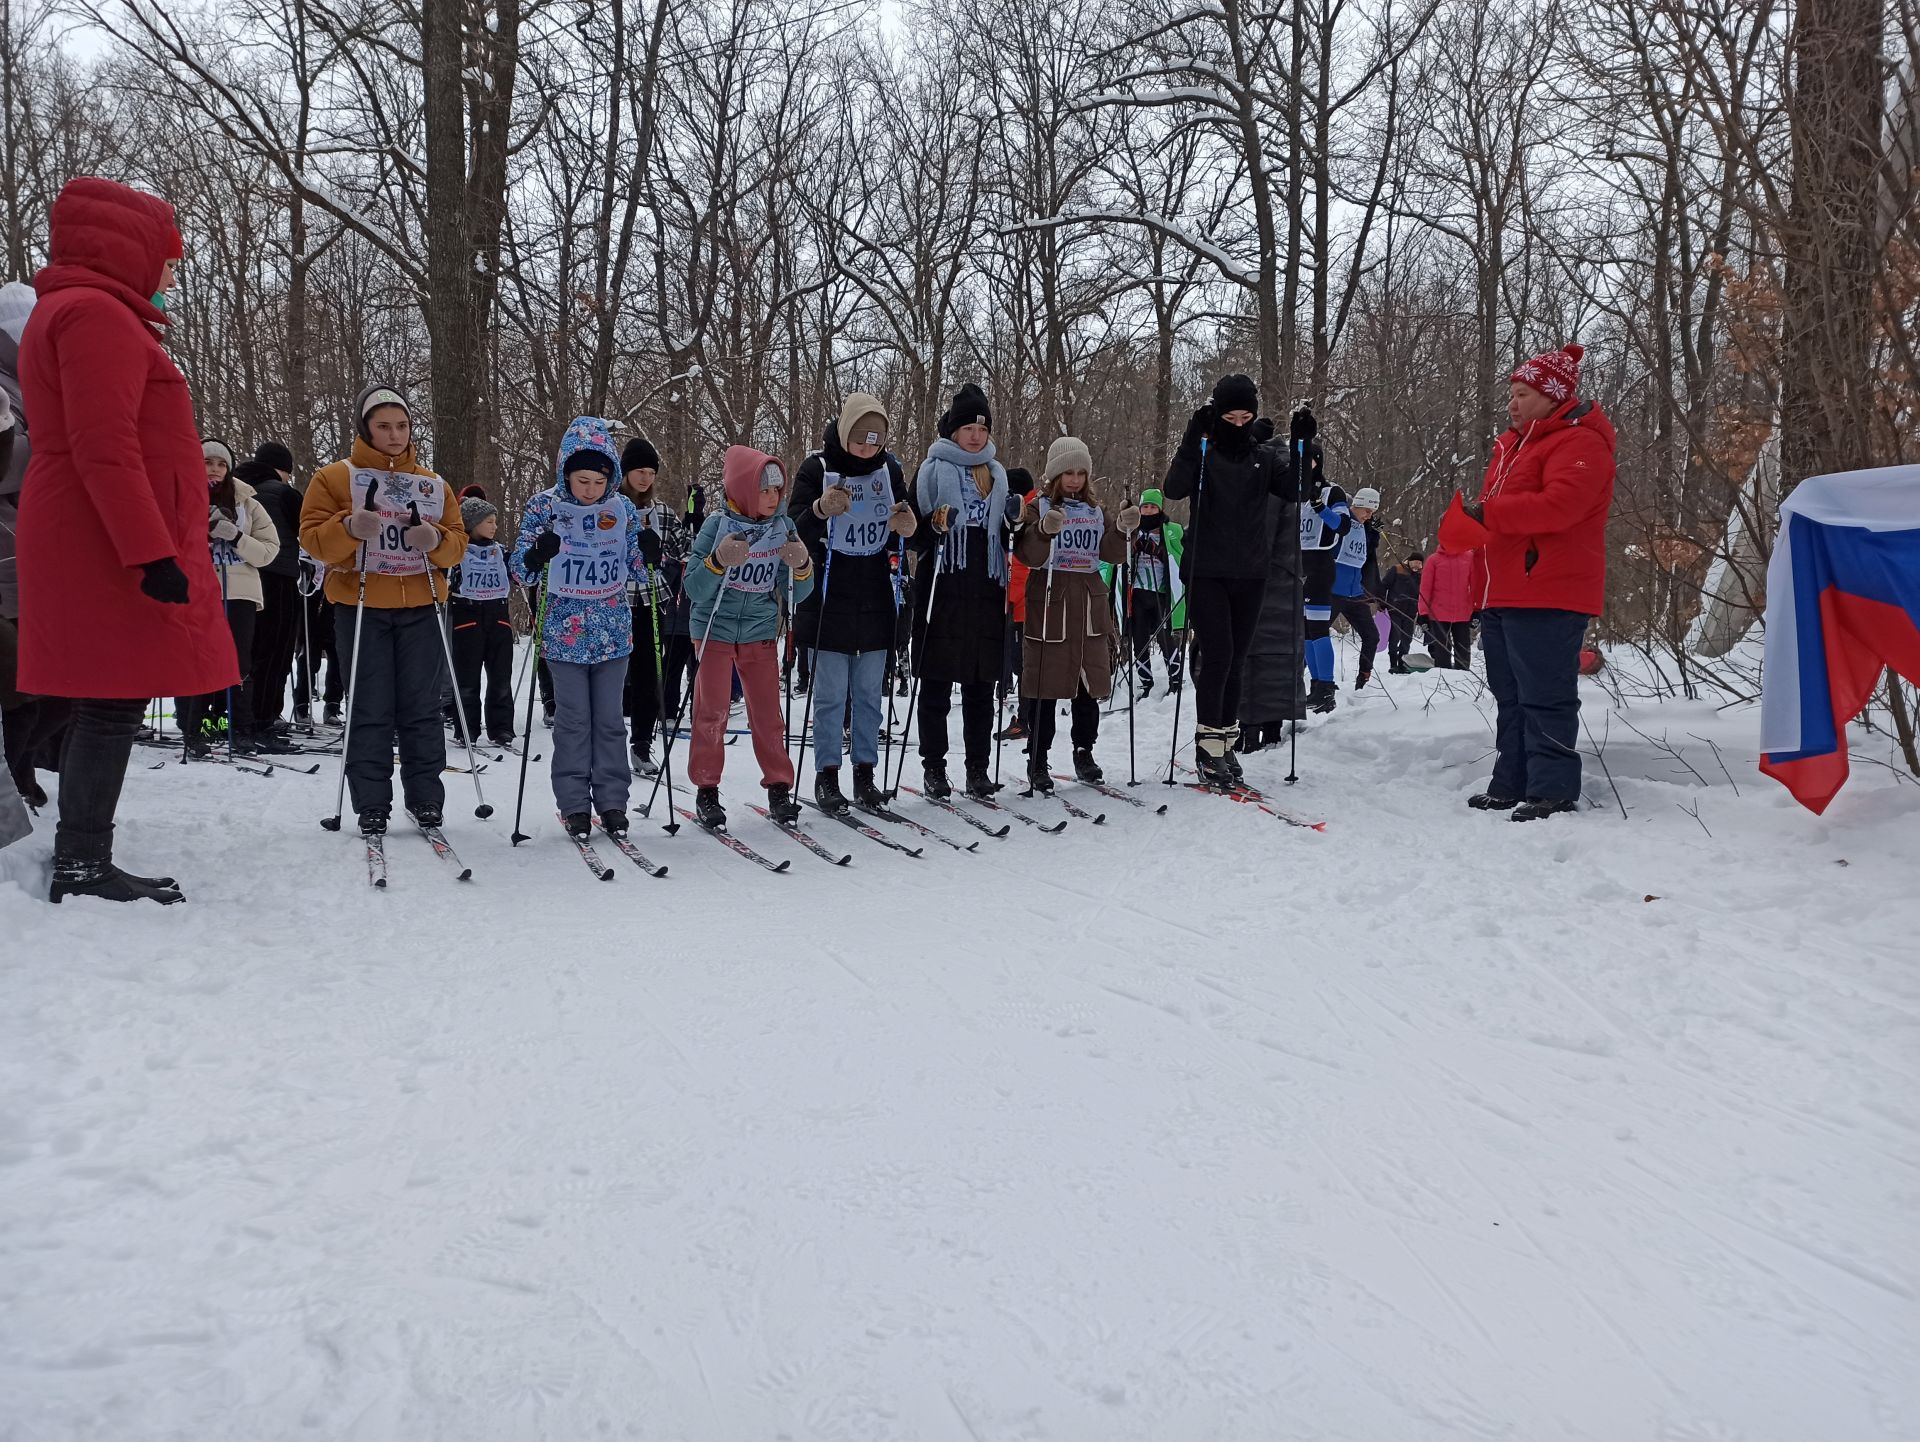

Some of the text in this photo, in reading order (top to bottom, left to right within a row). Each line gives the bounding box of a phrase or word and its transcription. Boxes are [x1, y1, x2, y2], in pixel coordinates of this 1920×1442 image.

[845, 520, 888, 547] 4187
[466, 572, 501, 588] 17433
[561, 558, 619, 586] 17436
[559, 586, 575, 594] XXV
